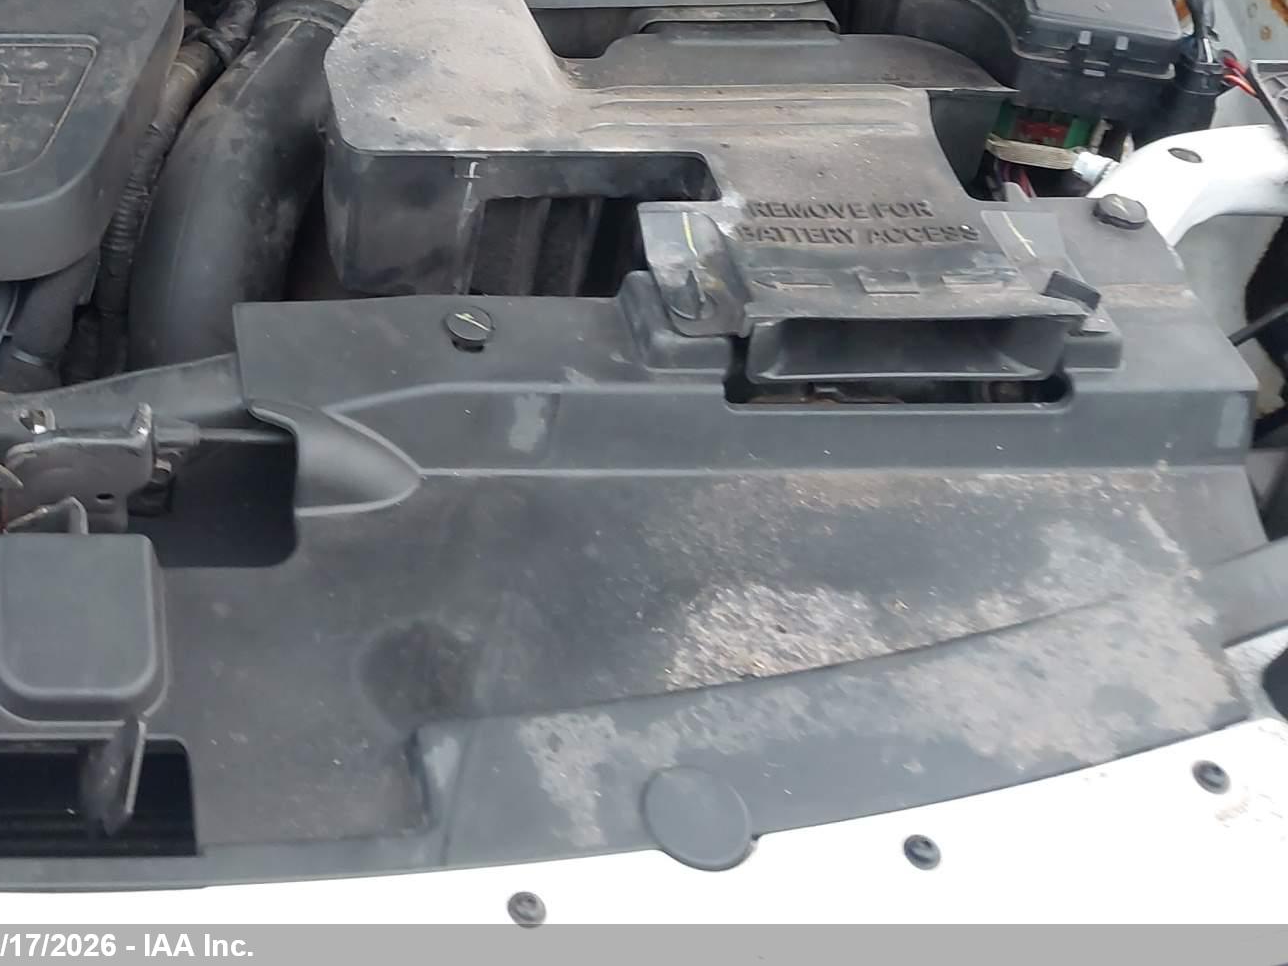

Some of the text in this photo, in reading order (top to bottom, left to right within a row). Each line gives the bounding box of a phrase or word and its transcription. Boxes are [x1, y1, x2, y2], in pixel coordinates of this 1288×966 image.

[746, 200, 934, 220] REMOVE FOR
[735, 224, 982, 245] BATTERY ACCESS
